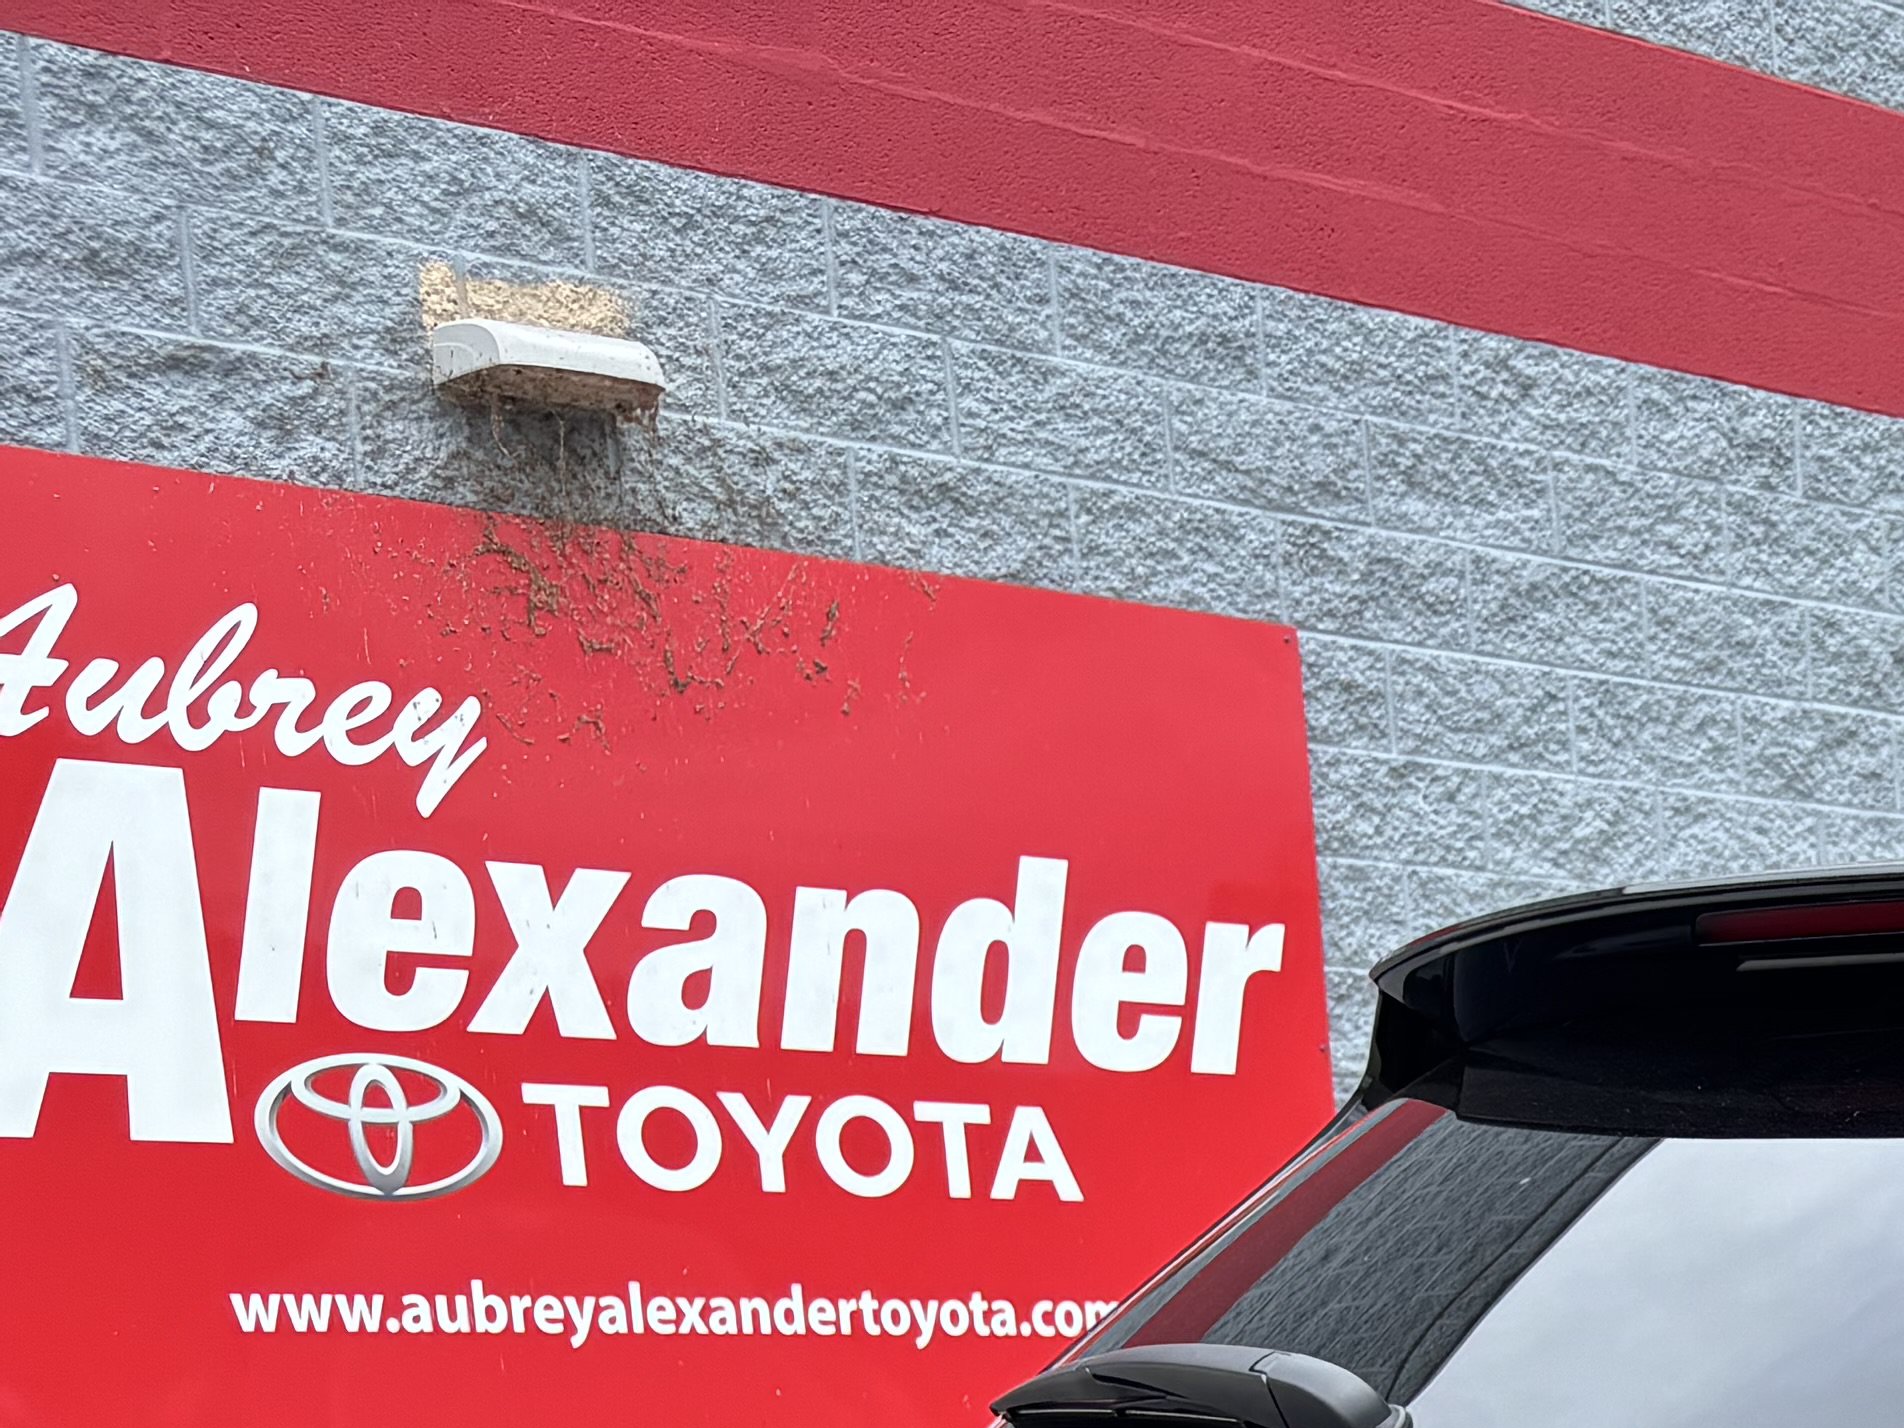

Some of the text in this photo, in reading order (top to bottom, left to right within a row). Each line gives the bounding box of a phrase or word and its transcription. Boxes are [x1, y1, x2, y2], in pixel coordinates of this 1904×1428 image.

[0, 583, 488, 819] Aubrey
[0, 758, 1286, 1144] Alexander
[522, 1082, 1085, 1202] TOYOTA
